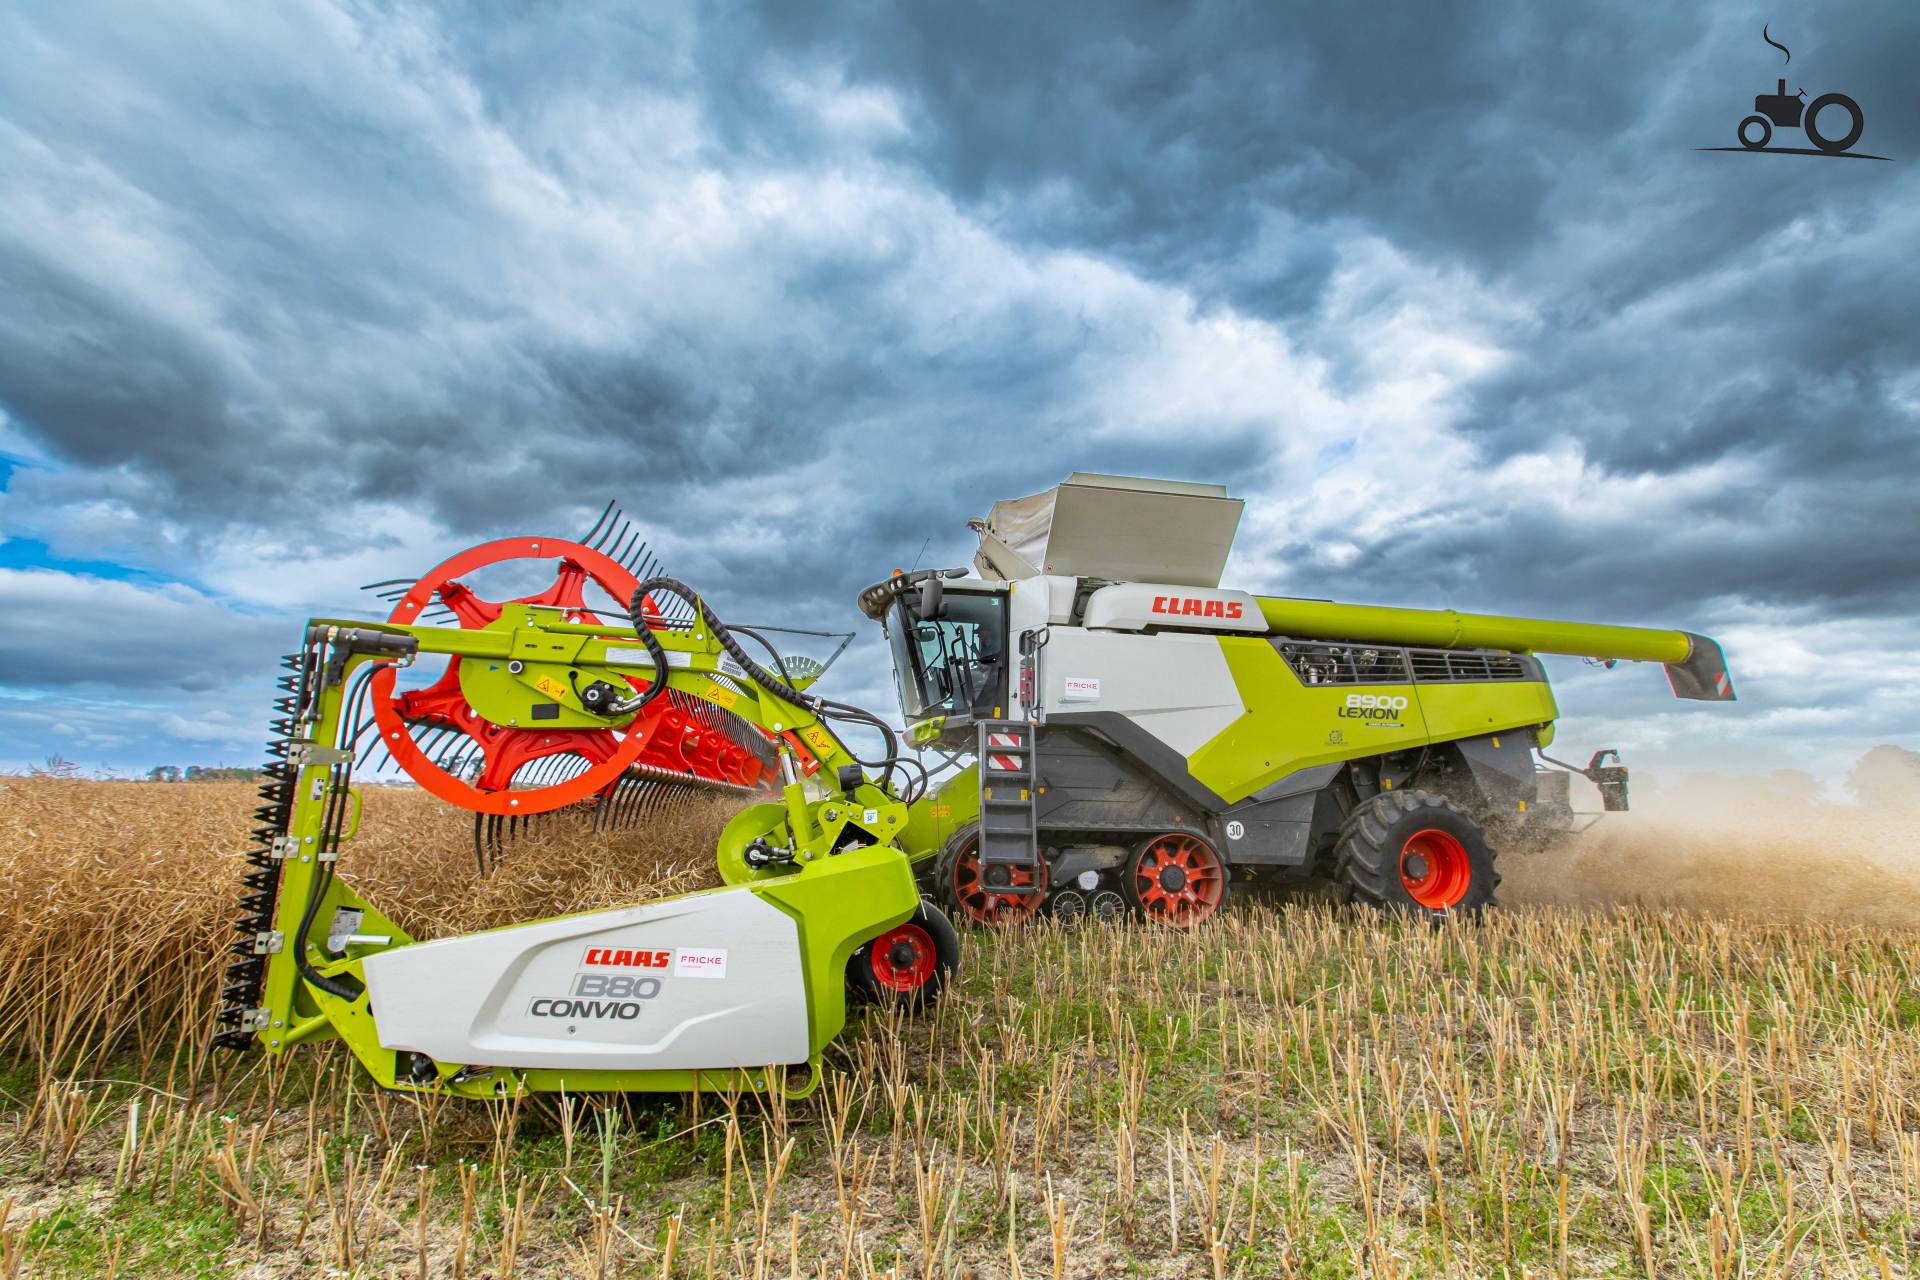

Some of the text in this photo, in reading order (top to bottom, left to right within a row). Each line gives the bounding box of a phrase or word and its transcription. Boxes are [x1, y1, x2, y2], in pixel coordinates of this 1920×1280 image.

[1152, 596, 1243, 618] CLAAS
[1346, 694, 1408, 709] 8900
[1338, 706, 1399, 720] LEXION
[1229, 824, 1241, 836] 30
[585, 949, 670, 968] CLAAS
[680, 955, 722, 964] FRICKE
[575, 975, 661, 1000] B80
[531, 999, 641, 1020] CONVIO
